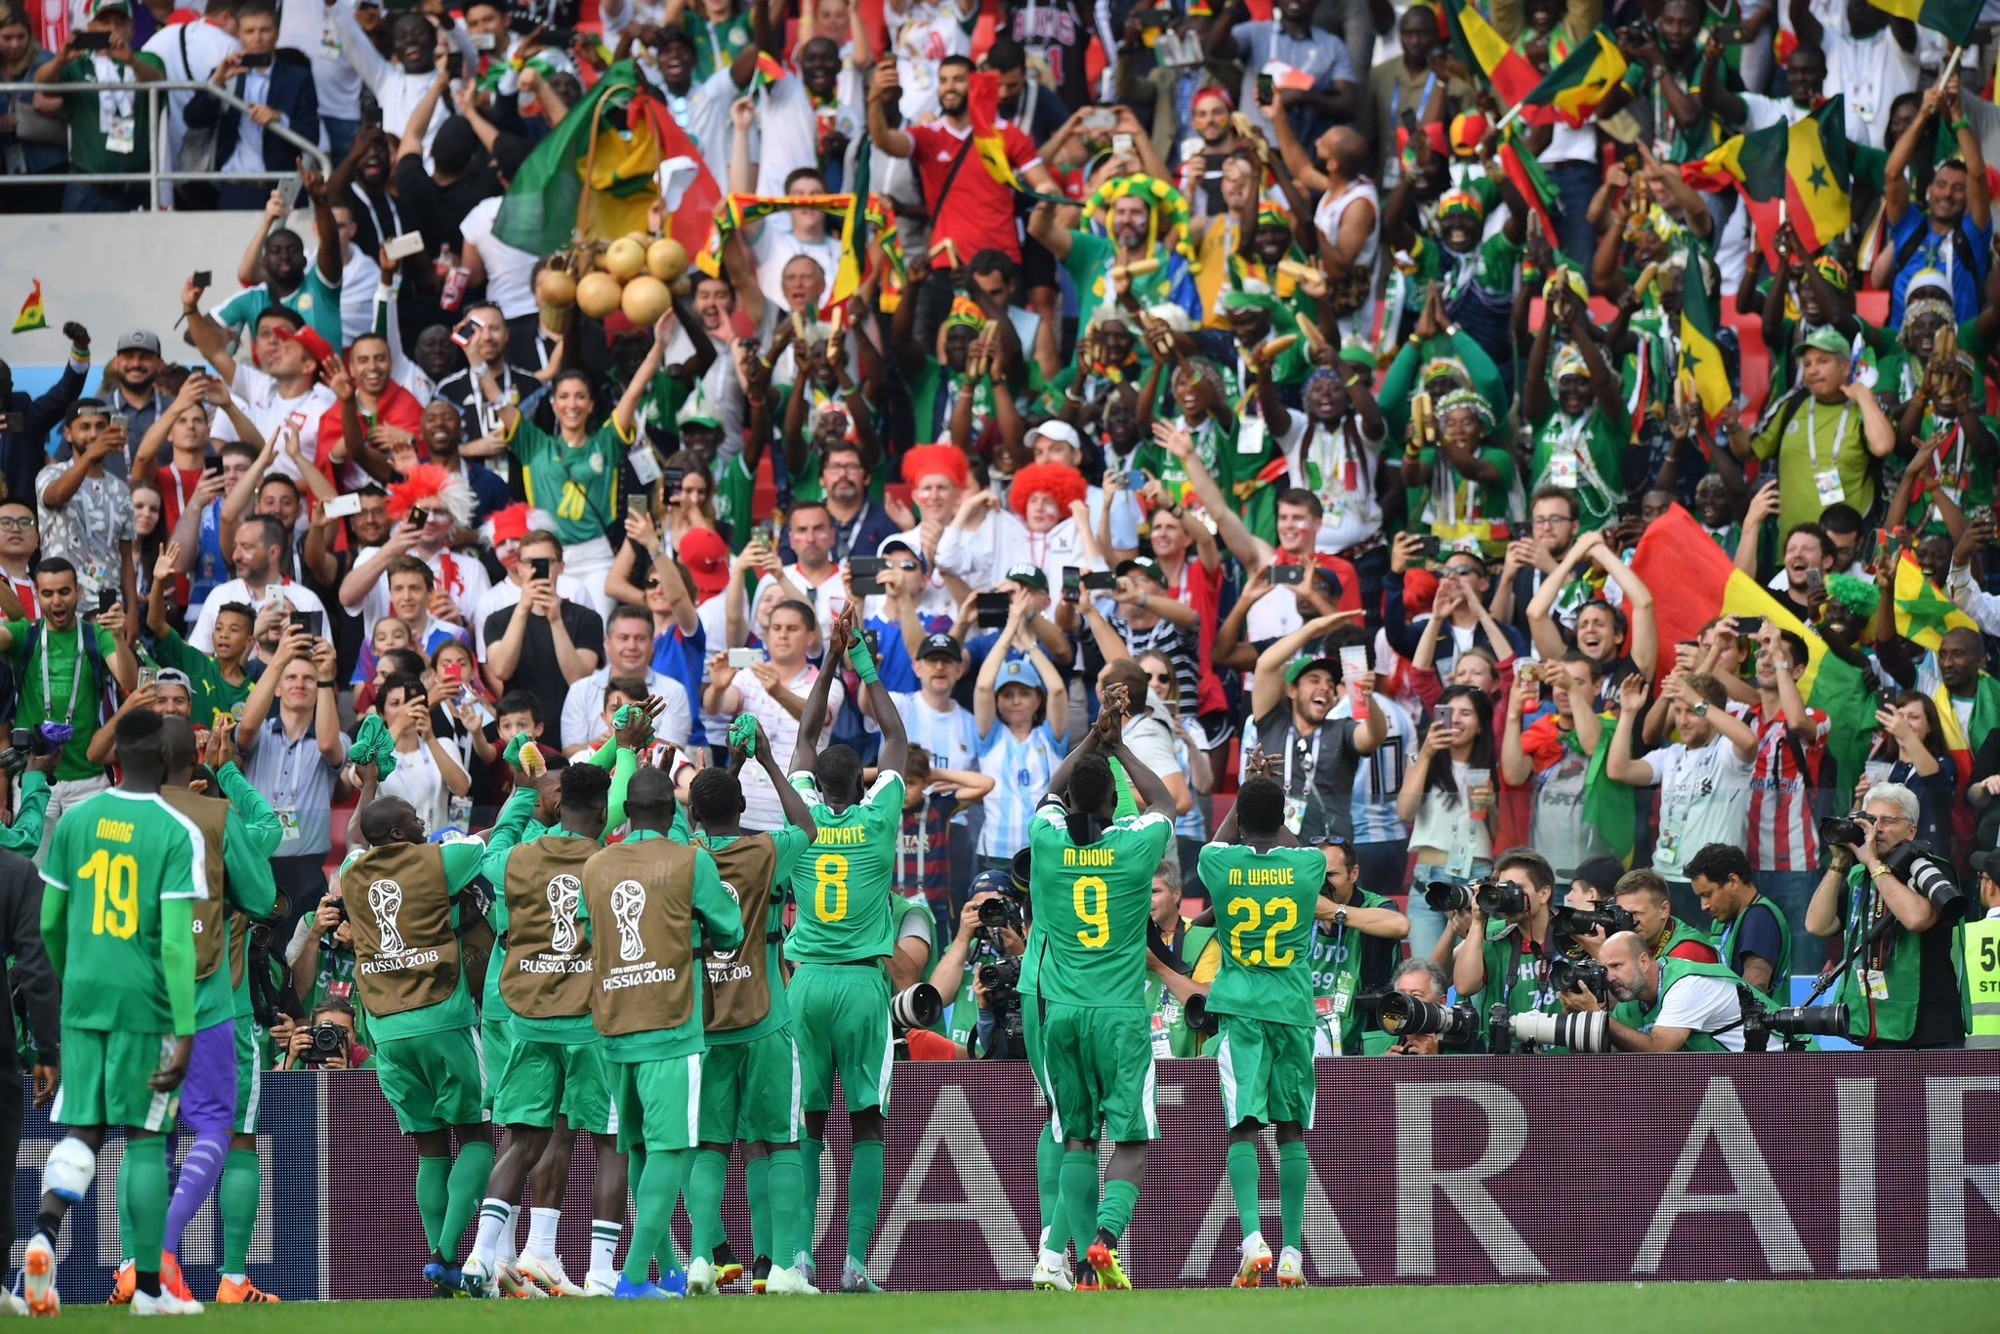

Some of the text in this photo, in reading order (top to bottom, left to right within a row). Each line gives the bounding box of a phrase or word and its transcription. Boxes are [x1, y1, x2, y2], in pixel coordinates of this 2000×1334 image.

[96, 818, 134, 843] NIANG
[816, 824, 866, 845] OUYATÉ
[77, 849, 139, 941] 19
[815, 853, 849, 923] 8
[1073, 876, 1110, 948] 9
[1227, 897, 1298, 967] 22
[361, 957, 405, 975] RUSSIA
[405, 949, 440, 969] 2018
[519, 959, 566, 973] RUSSIA
[644, 961, 657, 970] CUP
[1980, 937, 2000, 973] 5
[643, 967, 677, 983] 2018
[629, 1082, 1549, 1288] AAR
